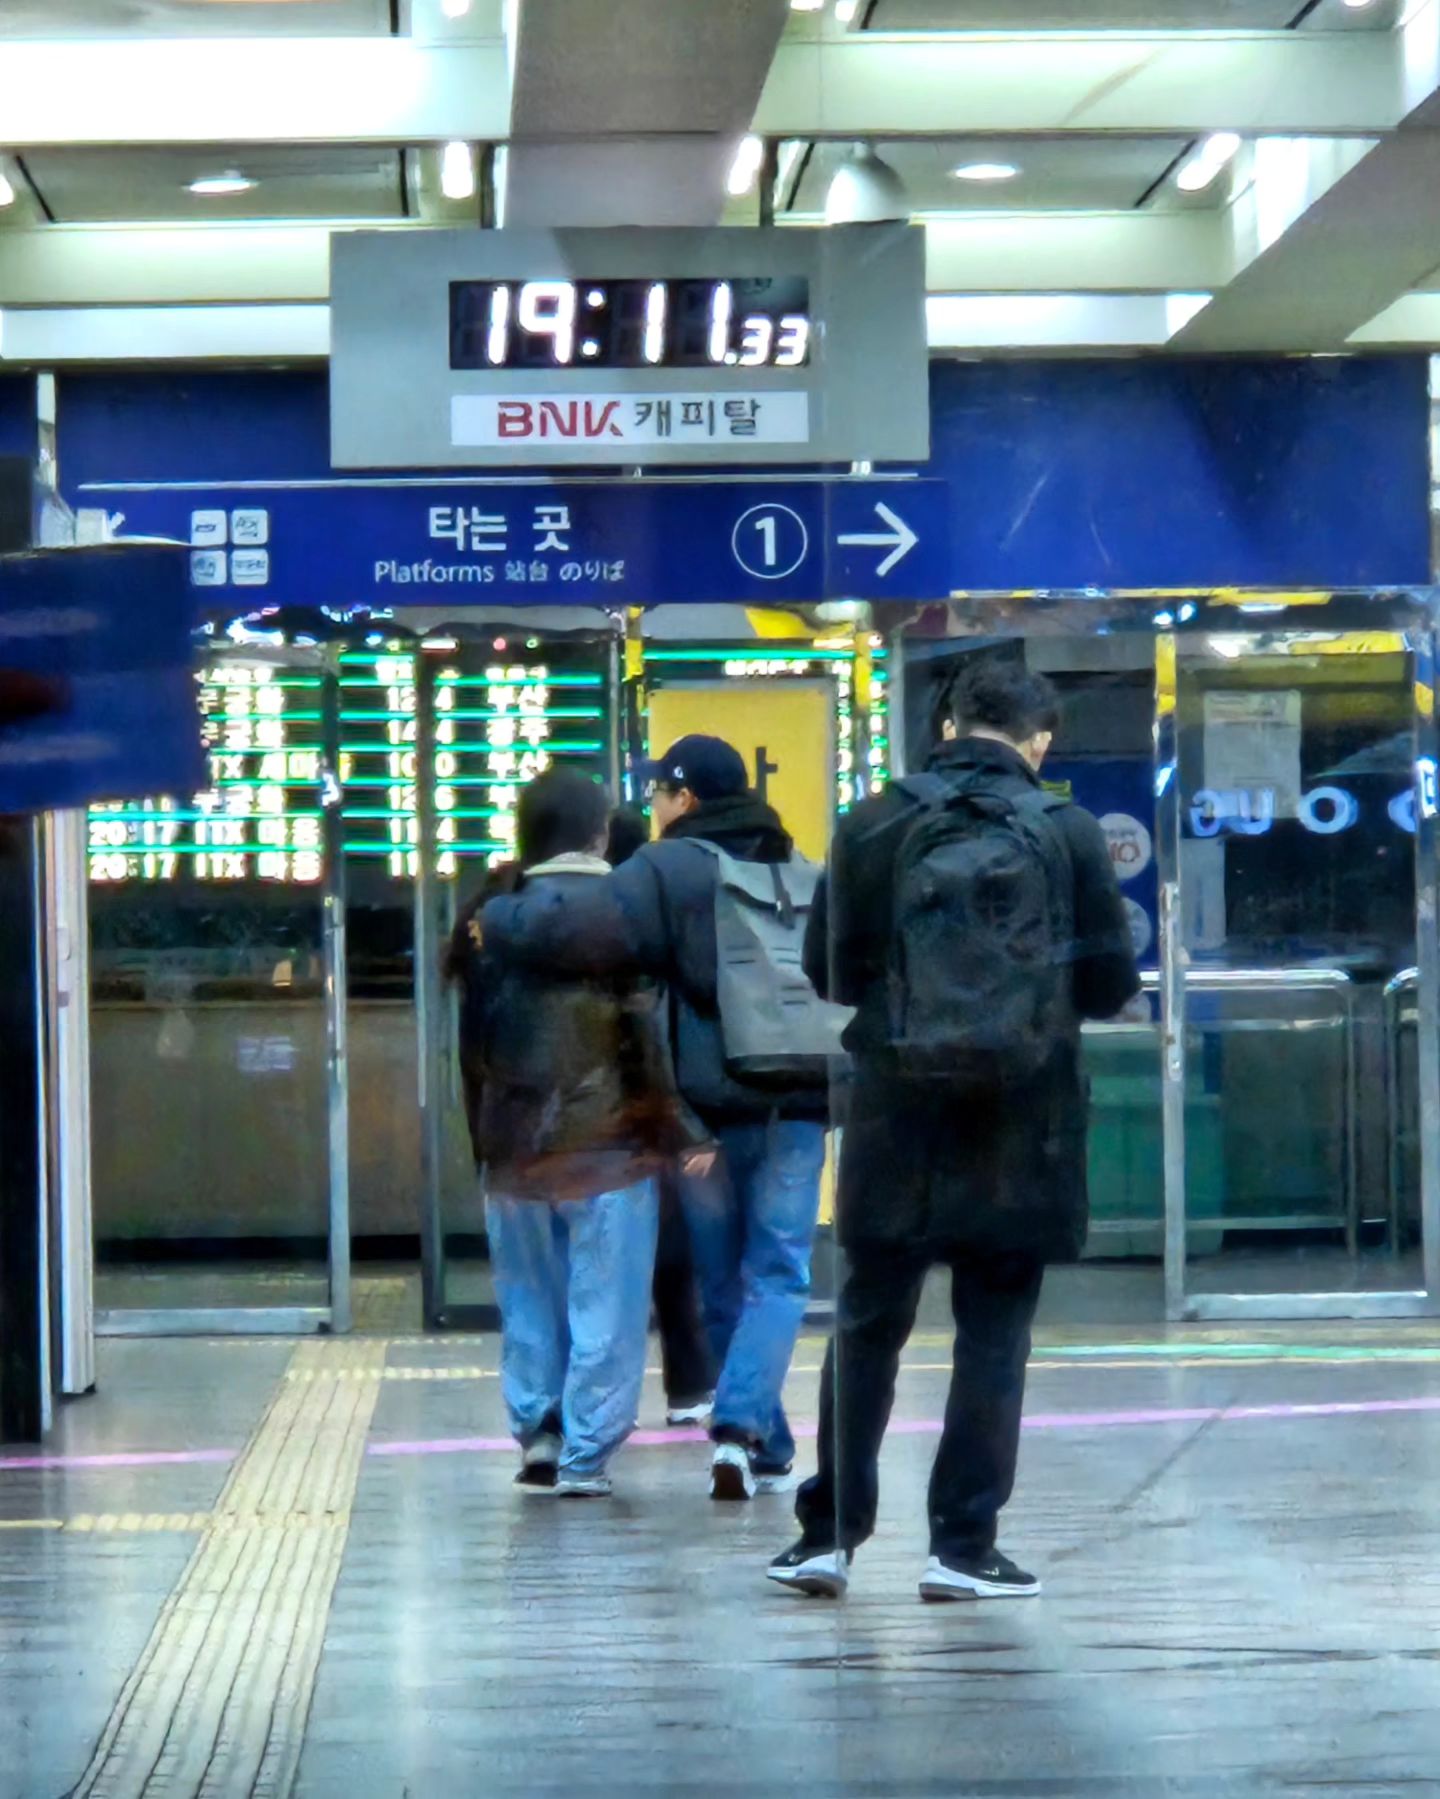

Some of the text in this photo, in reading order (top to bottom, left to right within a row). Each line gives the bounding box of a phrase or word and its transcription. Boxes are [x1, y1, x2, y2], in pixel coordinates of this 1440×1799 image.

[497, 399, 762, 438] BNK 캐피탈
[428, 505, 572, 552] 타는 곳
[374, 559, 494, 585] Platforms
[504, 560, 550, 583] 站台
